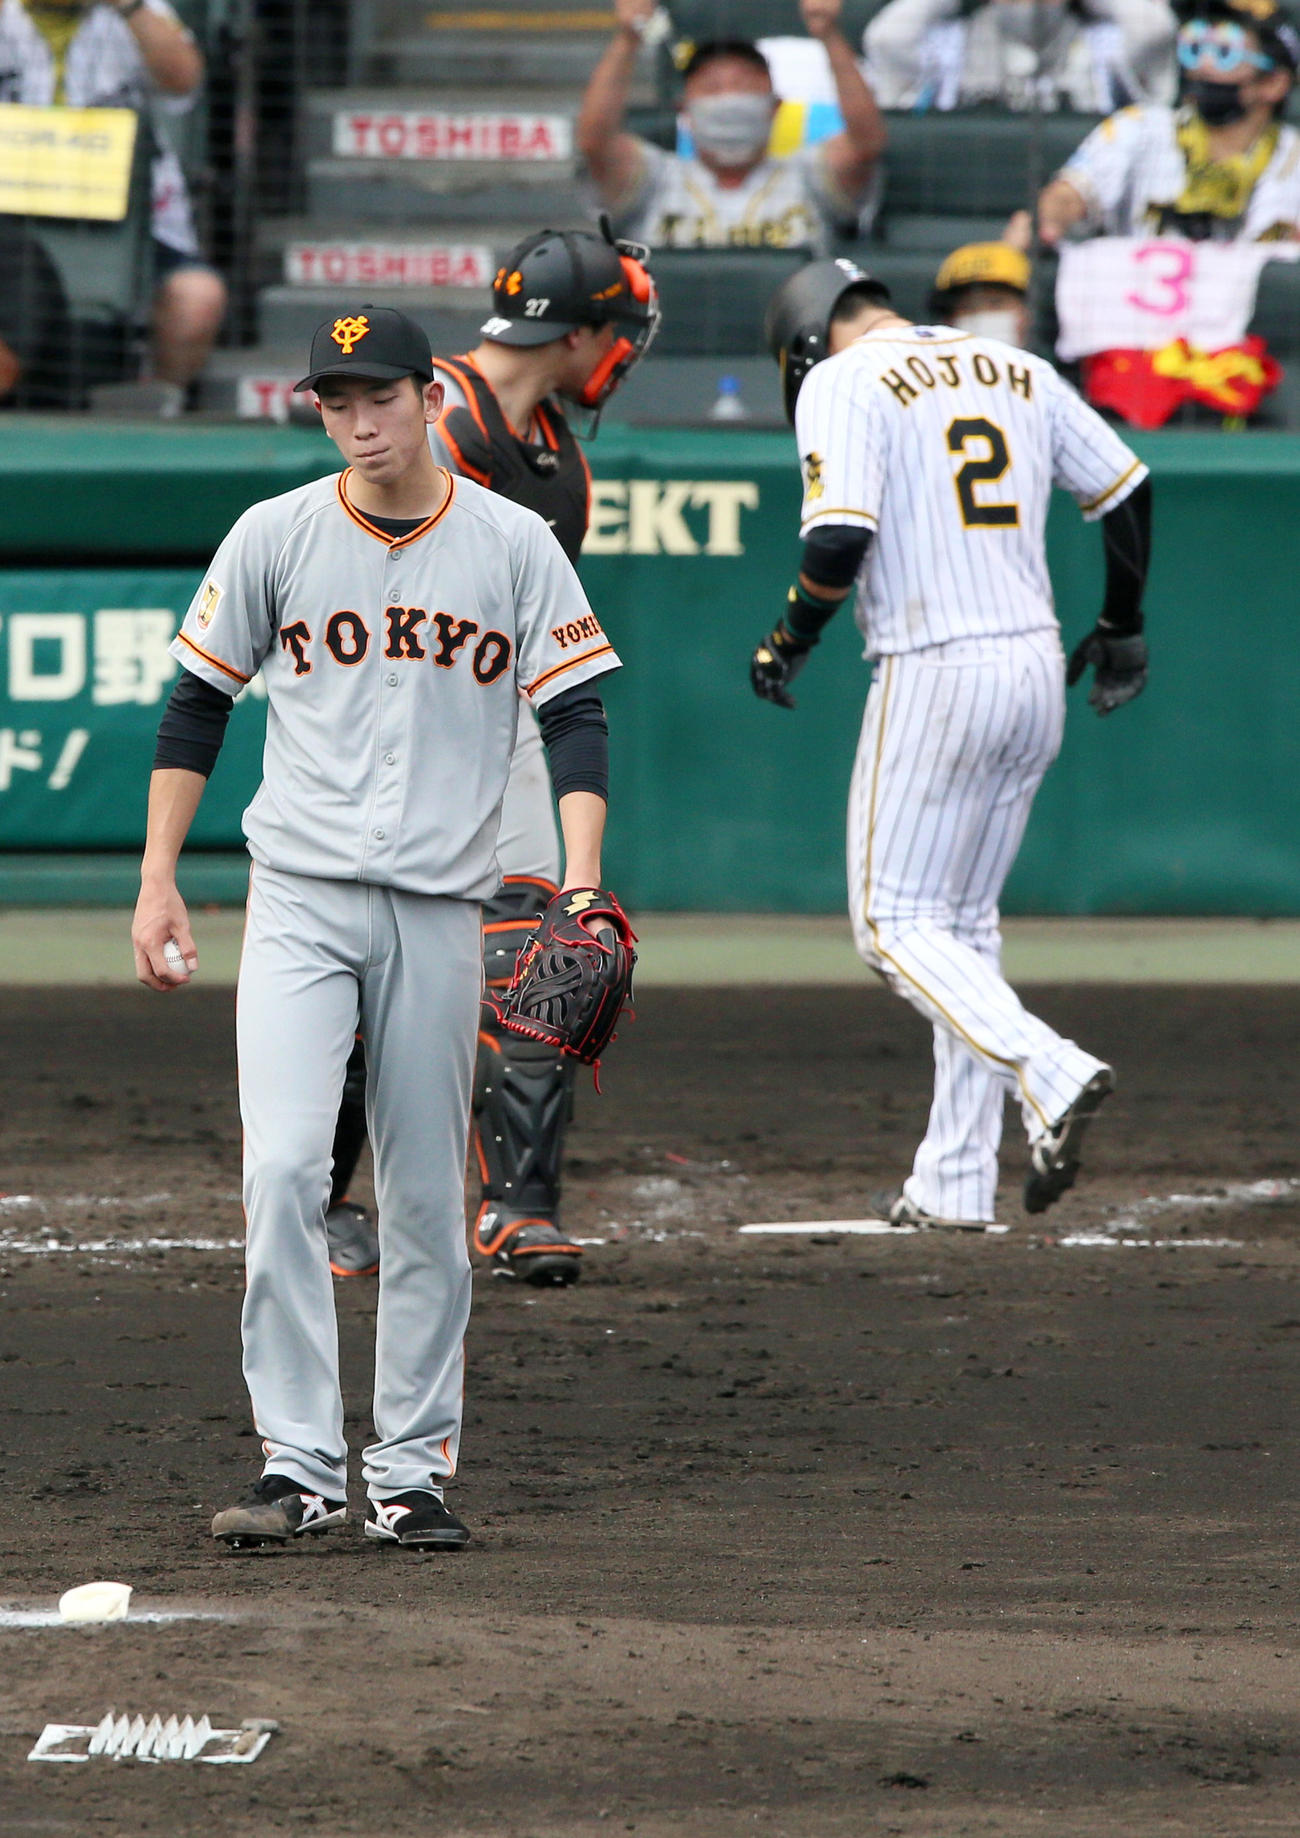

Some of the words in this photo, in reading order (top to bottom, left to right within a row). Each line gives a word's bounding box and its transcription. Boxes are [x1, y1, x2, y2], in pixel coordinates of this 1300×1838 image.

[351, 115, 555, 156] TOSHIBA
[296, 249, 480, 286] TOSHIBA
[1128, 242, 1194, 315] 3
[523, 298, 551, 318] 27
[880, 353, 1032, 408] HOJOH
[944, 416, 1021, 529] 2
[279, 606, 512, 686] TOKYO
